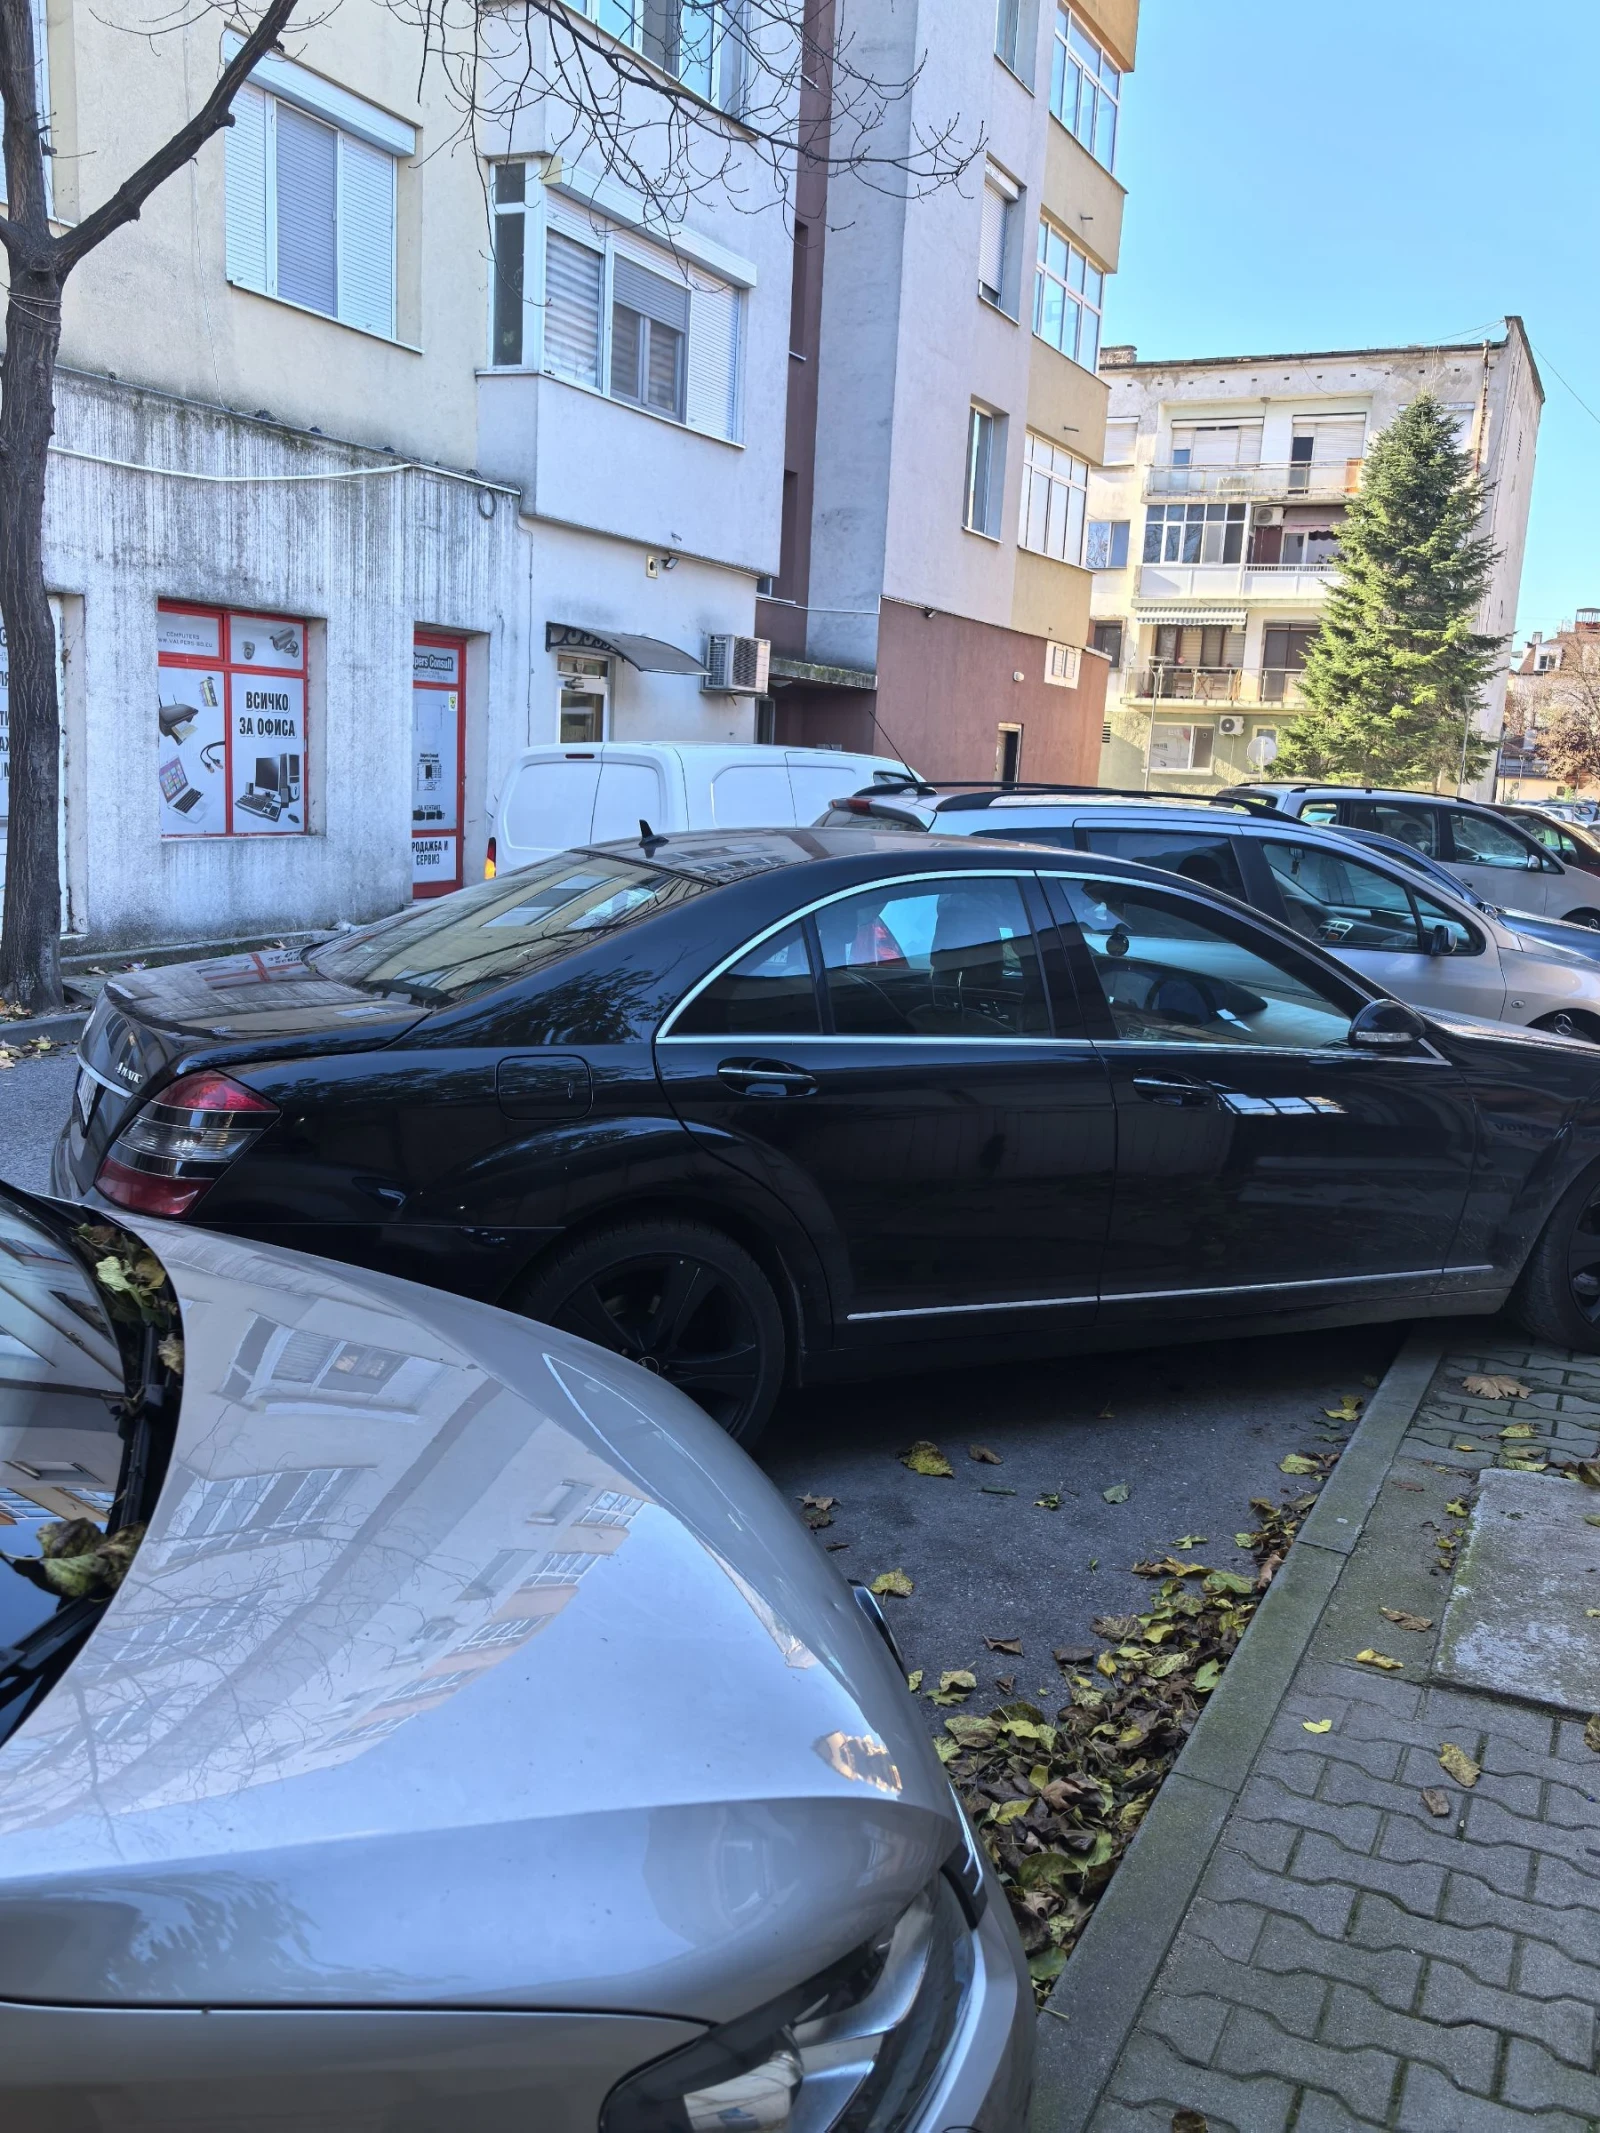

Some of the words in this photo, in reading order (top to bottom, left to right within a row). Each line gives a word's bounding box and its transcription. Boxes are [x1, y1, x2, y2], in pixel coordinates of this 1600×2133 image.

[166, 631, 200, 640] COMPUTERS
[413, 652, 429, 670] pers
[429, 654, 453, 671] Consult
[246, 691, 289, 712] ВСИЧКО
[239, 716, 254, 736] ЗА
[257, 717, 296, 737] ОФИСА
[411, 841, 442, 854] РОДАЖБА
[416, 854, 440, 866] СЕРВИЗ
